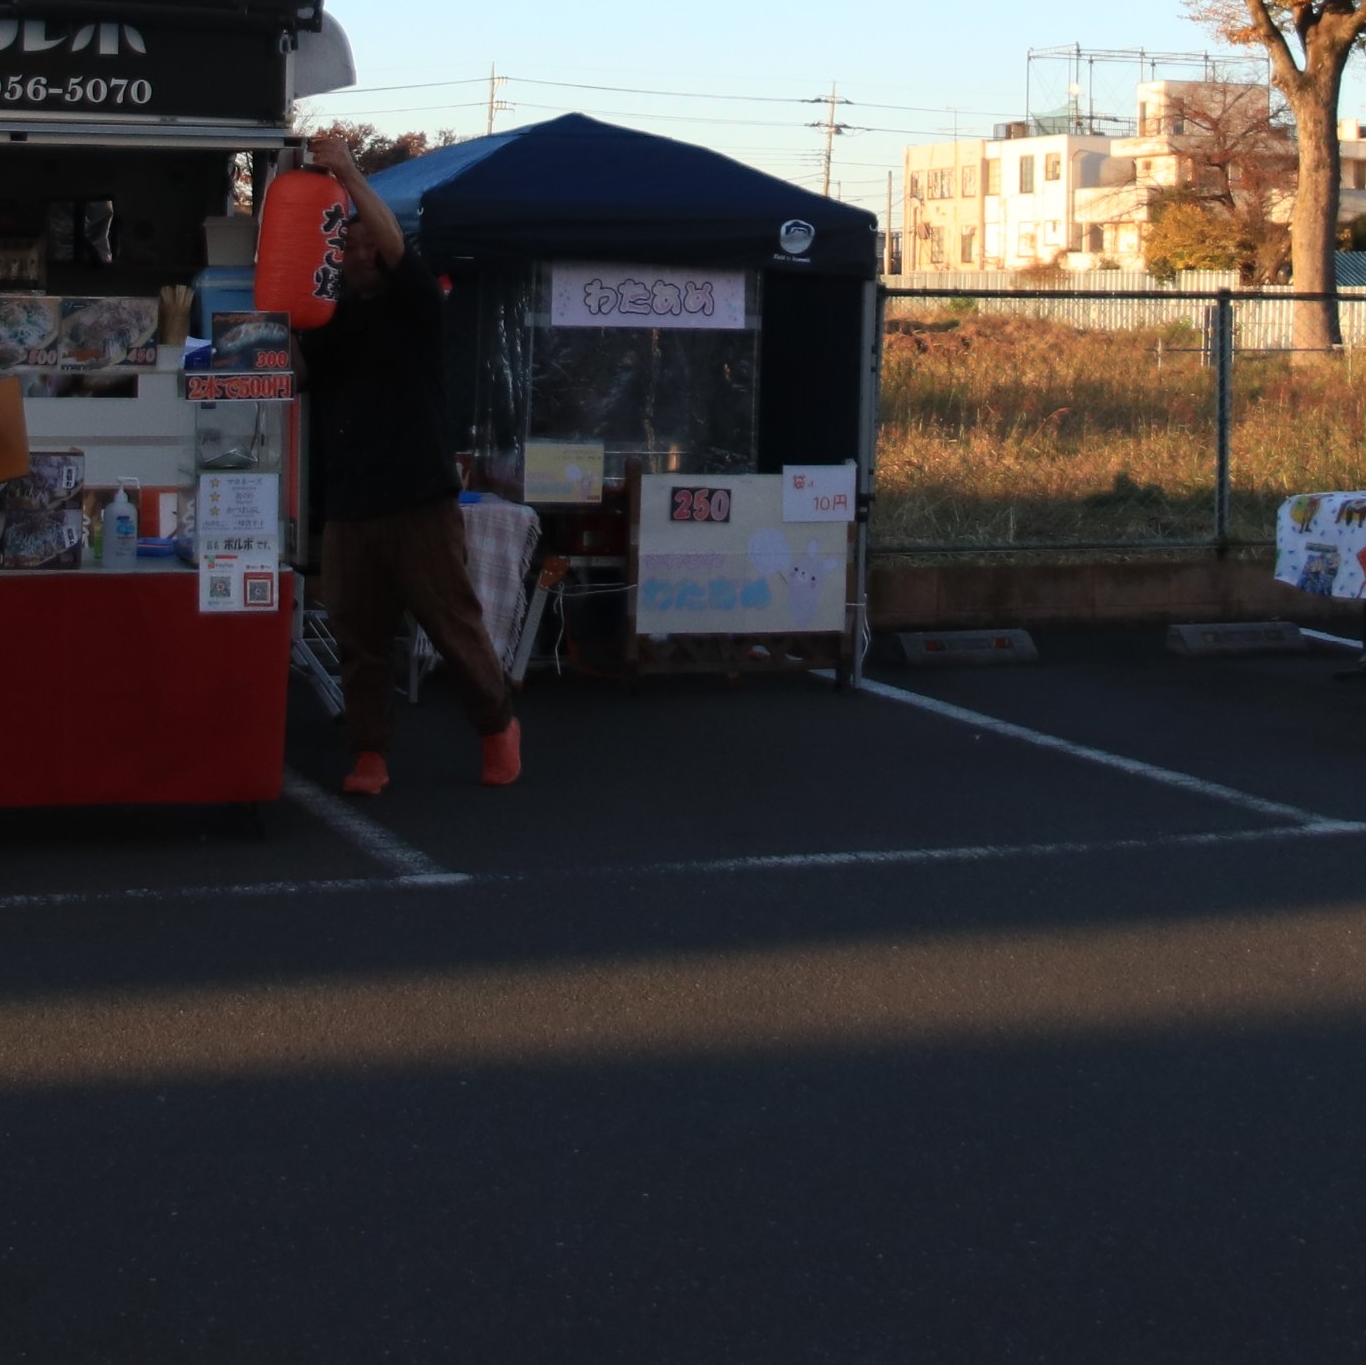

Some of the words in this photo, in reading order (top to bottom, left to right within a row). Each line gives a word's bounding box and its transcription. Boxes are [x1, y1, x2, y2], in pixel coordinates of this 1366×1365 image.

[584, 278, 715, 316] わたあめ
[256, 351, 289, 368] 300
[188, 374, 292, 399] 2本で500円
[673, 488, 730, 522] 250
[813, 494, 848, 512] 10円
